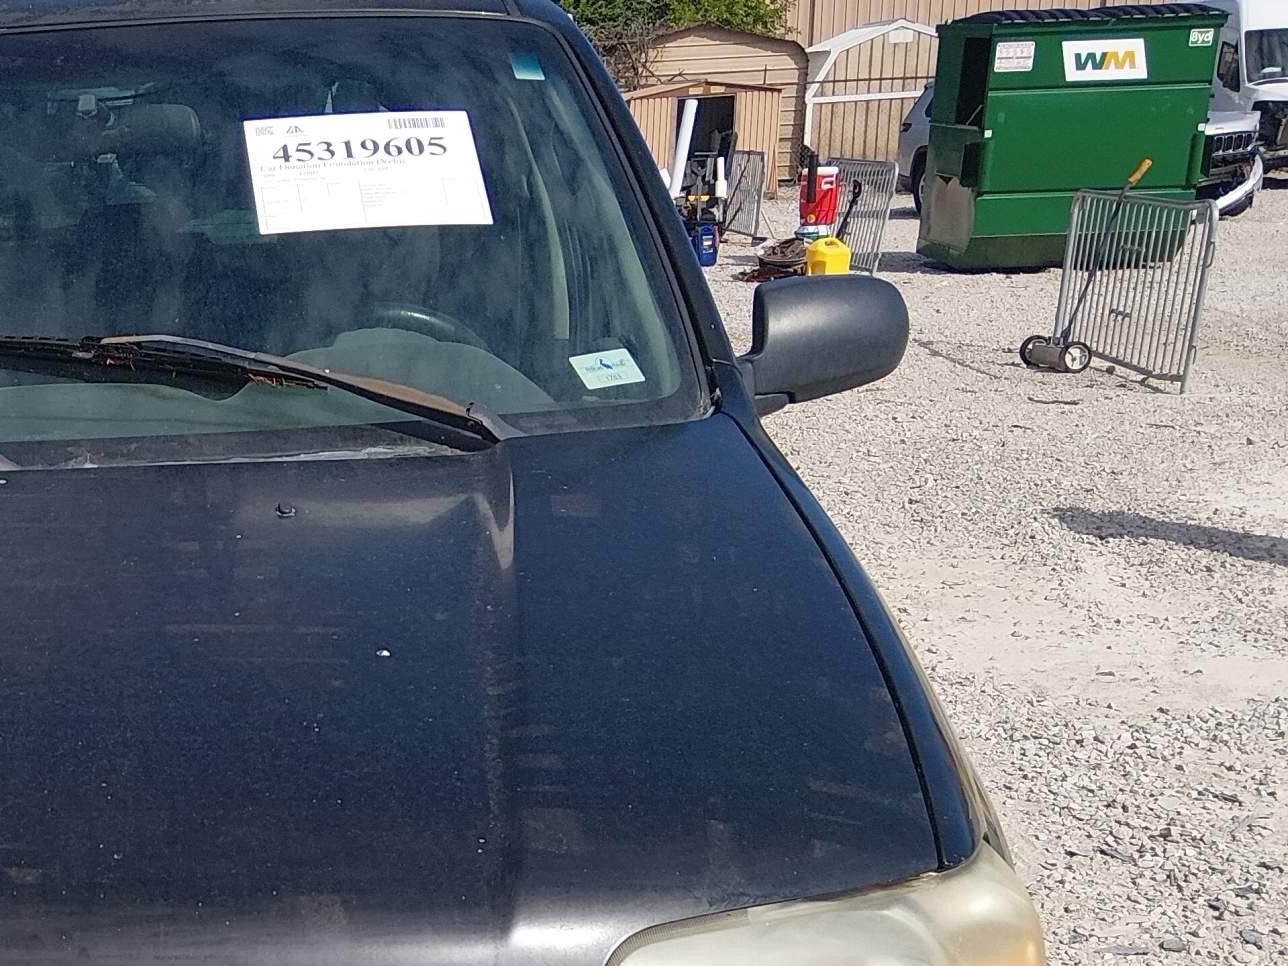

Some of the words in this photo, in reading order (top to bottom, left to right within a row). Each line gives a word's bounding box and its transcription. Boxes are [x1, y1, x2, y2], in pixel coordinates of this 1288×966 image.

[1191, 31, 1213, 43] 8yd
[1074, 50, 1136, 71] WM
[273, 136, 447, 162] 45319605
